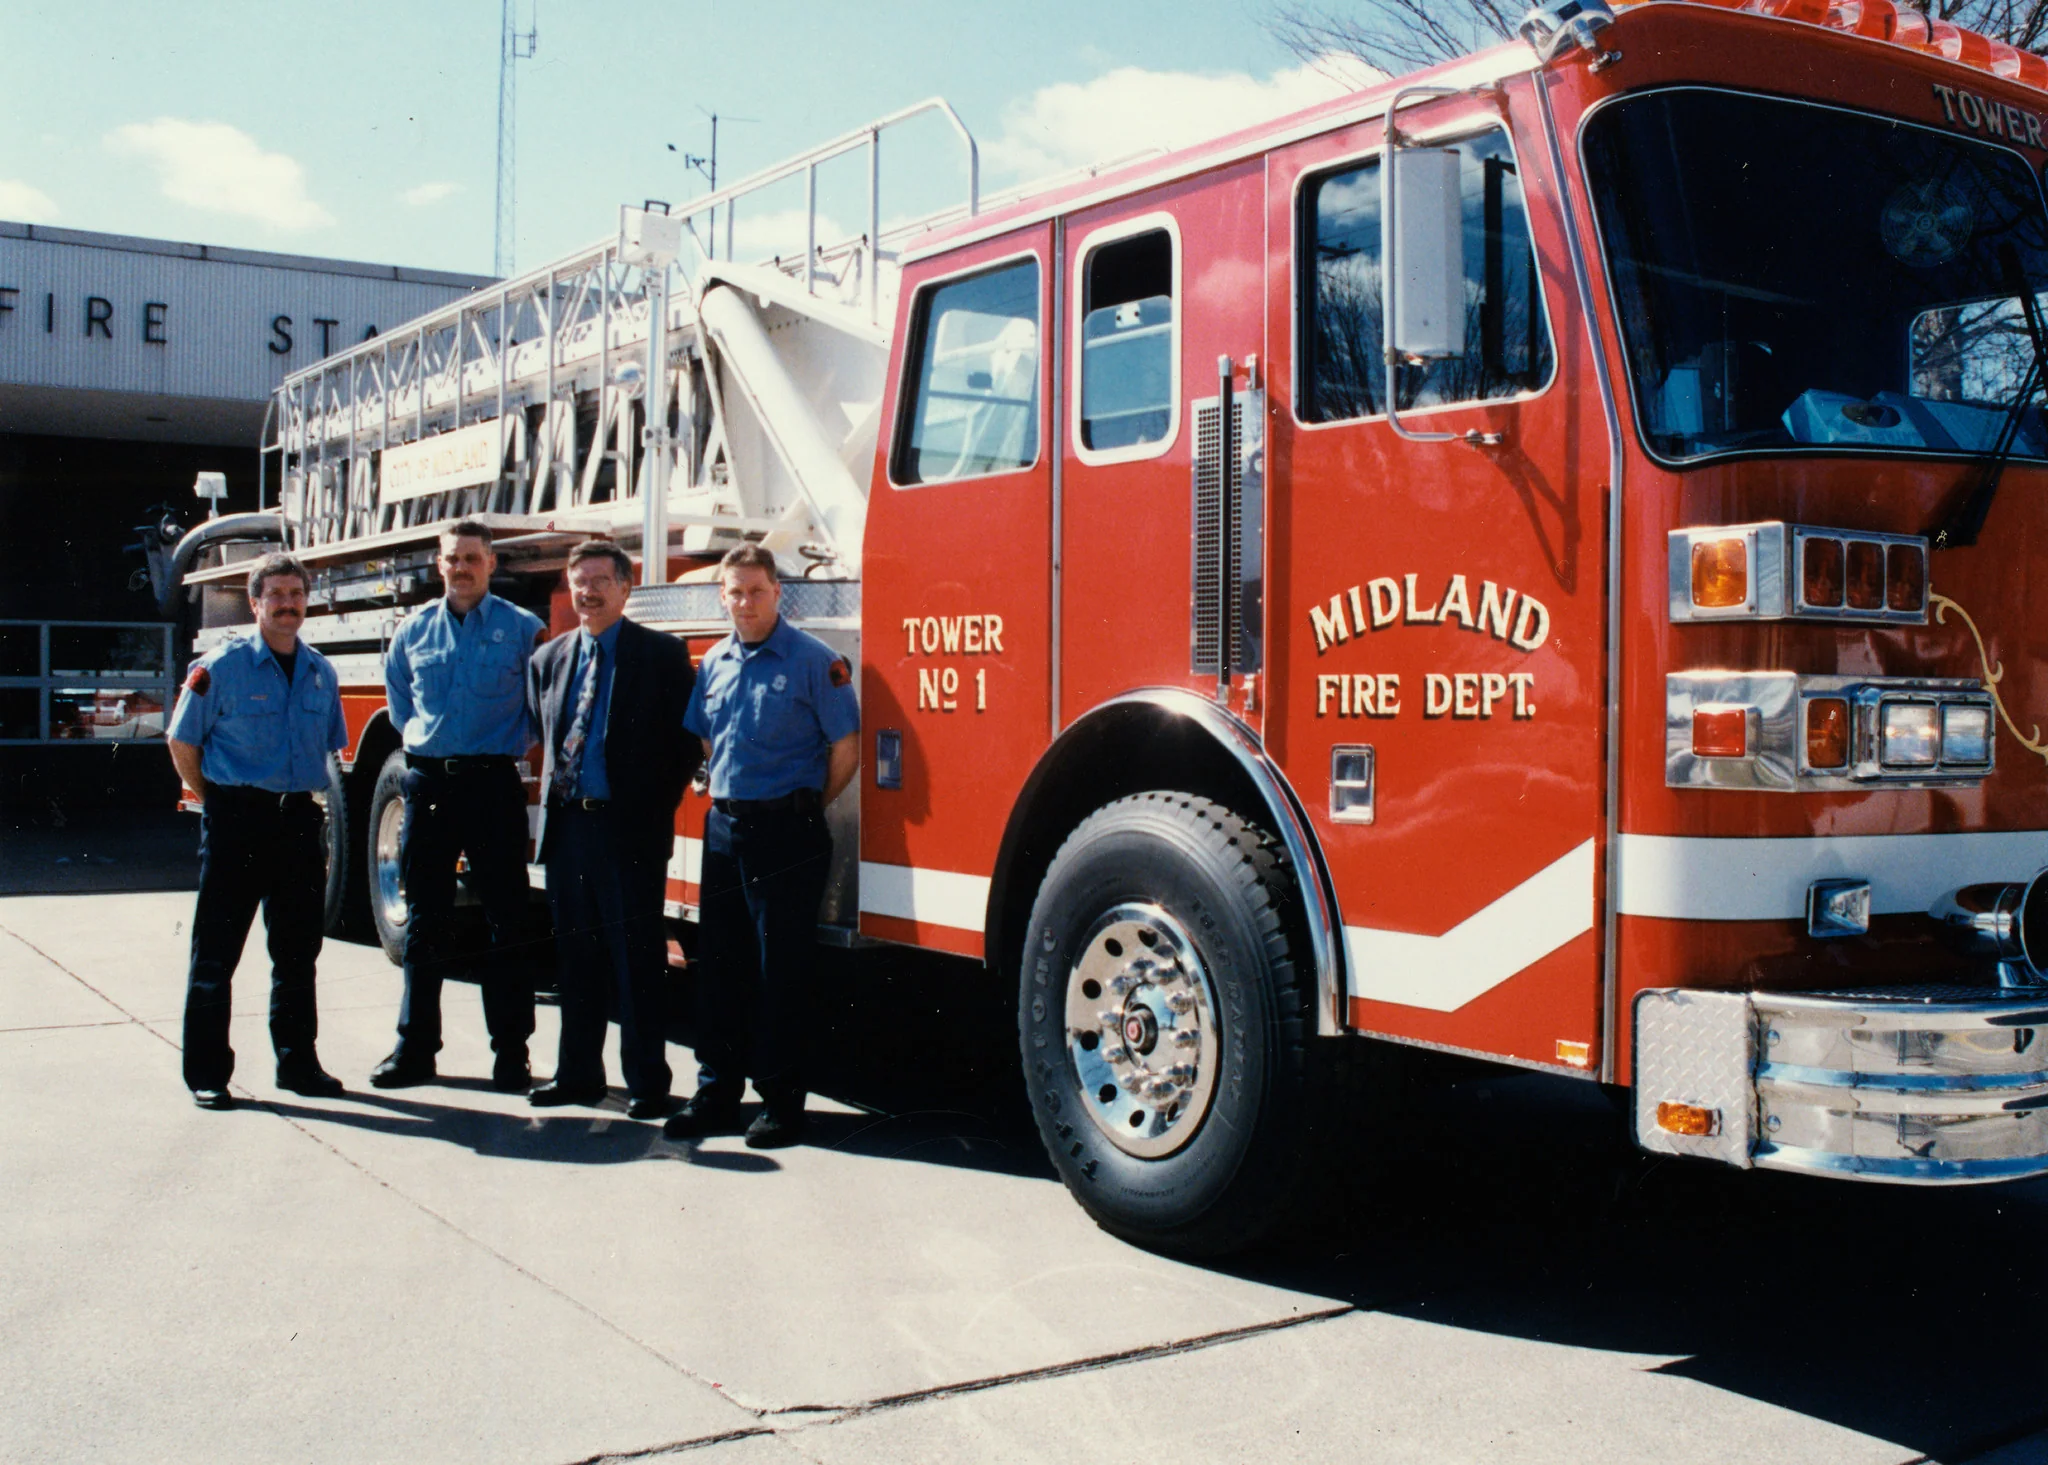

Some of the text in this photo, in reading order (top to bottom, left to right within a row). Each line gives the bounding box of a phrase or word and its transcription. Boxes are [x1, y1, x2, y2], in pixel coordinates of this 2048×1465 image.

[1932, 83, 2047, 151] TOWER
[902, 614, 1004, 655] TOWER
[1309, 573, 1550, 653] MIDLAND
[975, 668, 986, 711] 1
[1317, 673, 1537, 718] FIRE DEPT.
